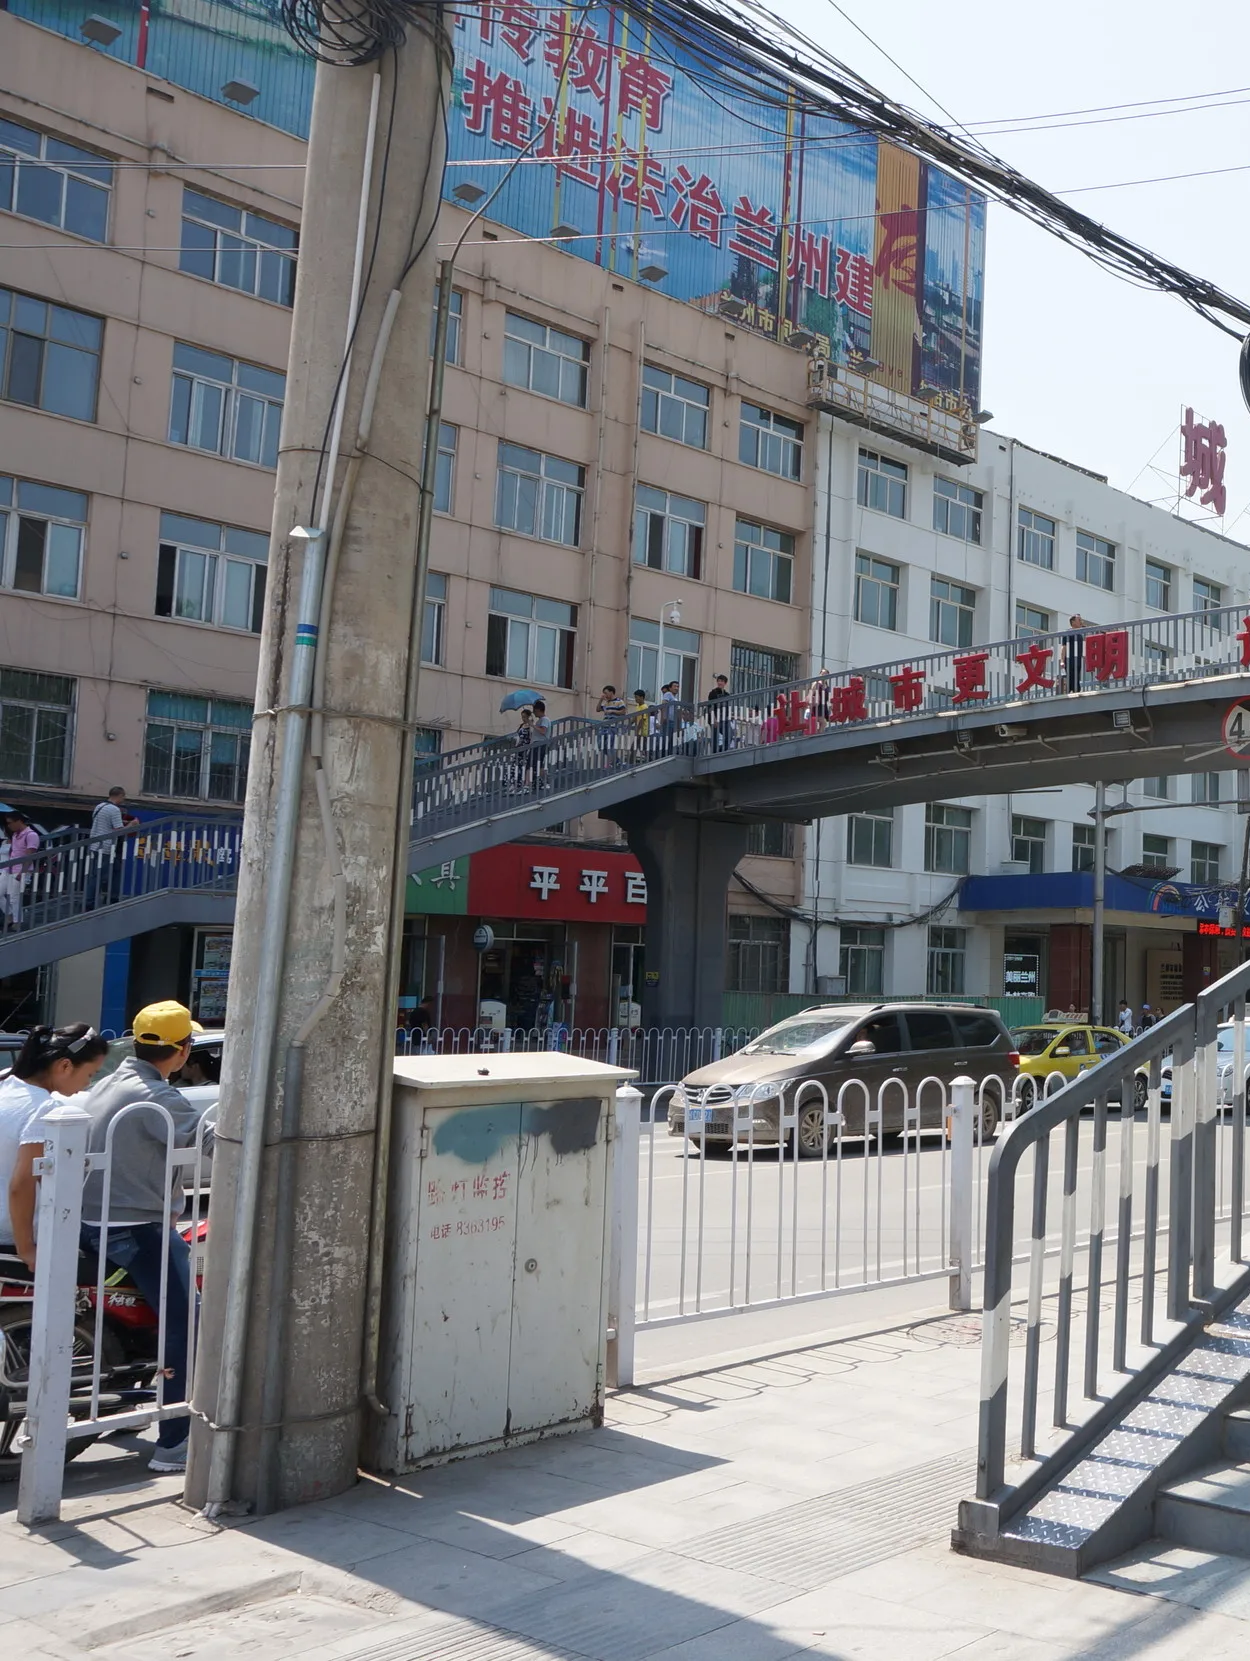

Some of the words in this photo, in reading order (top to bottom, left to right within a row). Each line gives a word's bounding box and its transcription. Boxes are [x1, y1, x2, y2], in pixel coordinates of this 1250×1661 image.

[455, 0, 674, 132] 传教育
[462, 58, 873, 318] 推进法治兰州建
[774, 630, 1130, 736] 让城市更文明
[529, 866, 648, 905] 平平百
[430, 1223, 452, 1240] 电话
